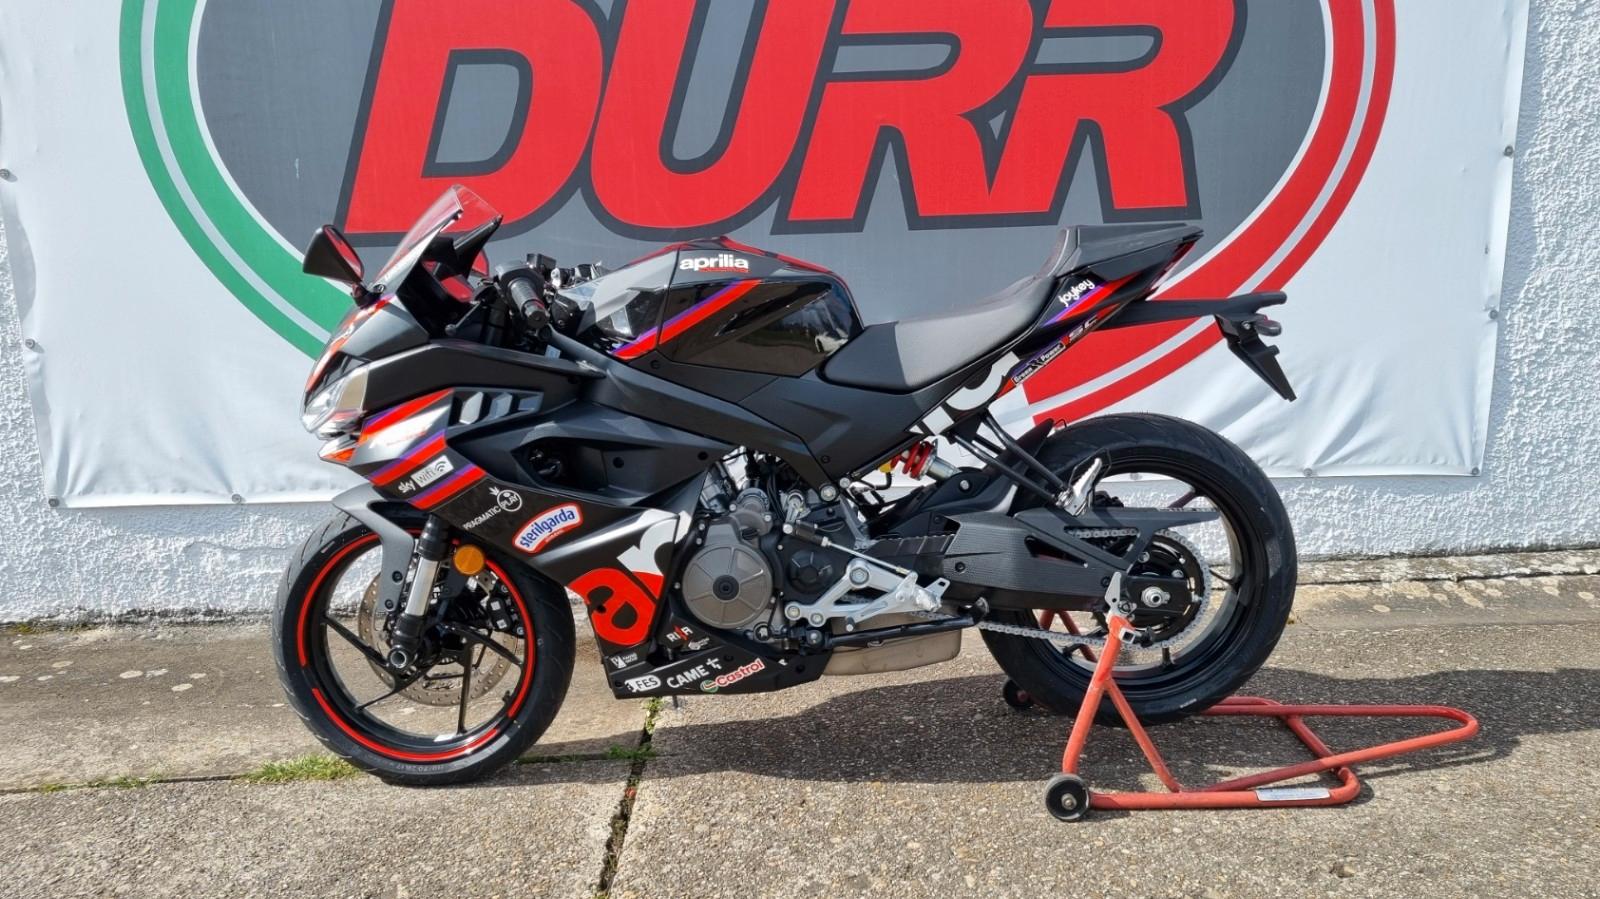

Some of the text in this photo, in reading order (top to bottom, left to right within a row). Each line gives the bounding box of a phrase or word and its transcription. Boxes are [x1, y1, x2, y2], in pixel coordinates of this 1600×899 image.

[680, 253, 749, 271] aprilia
[398, 480, 417, 494] sky
[462, 494, 519, 531] PRAGMATIC PLAY
[519, 508, 576, 548] sterilgarda
[667, 664, 710, 688] CAME
[716, 658, 765, 686] Castrol
